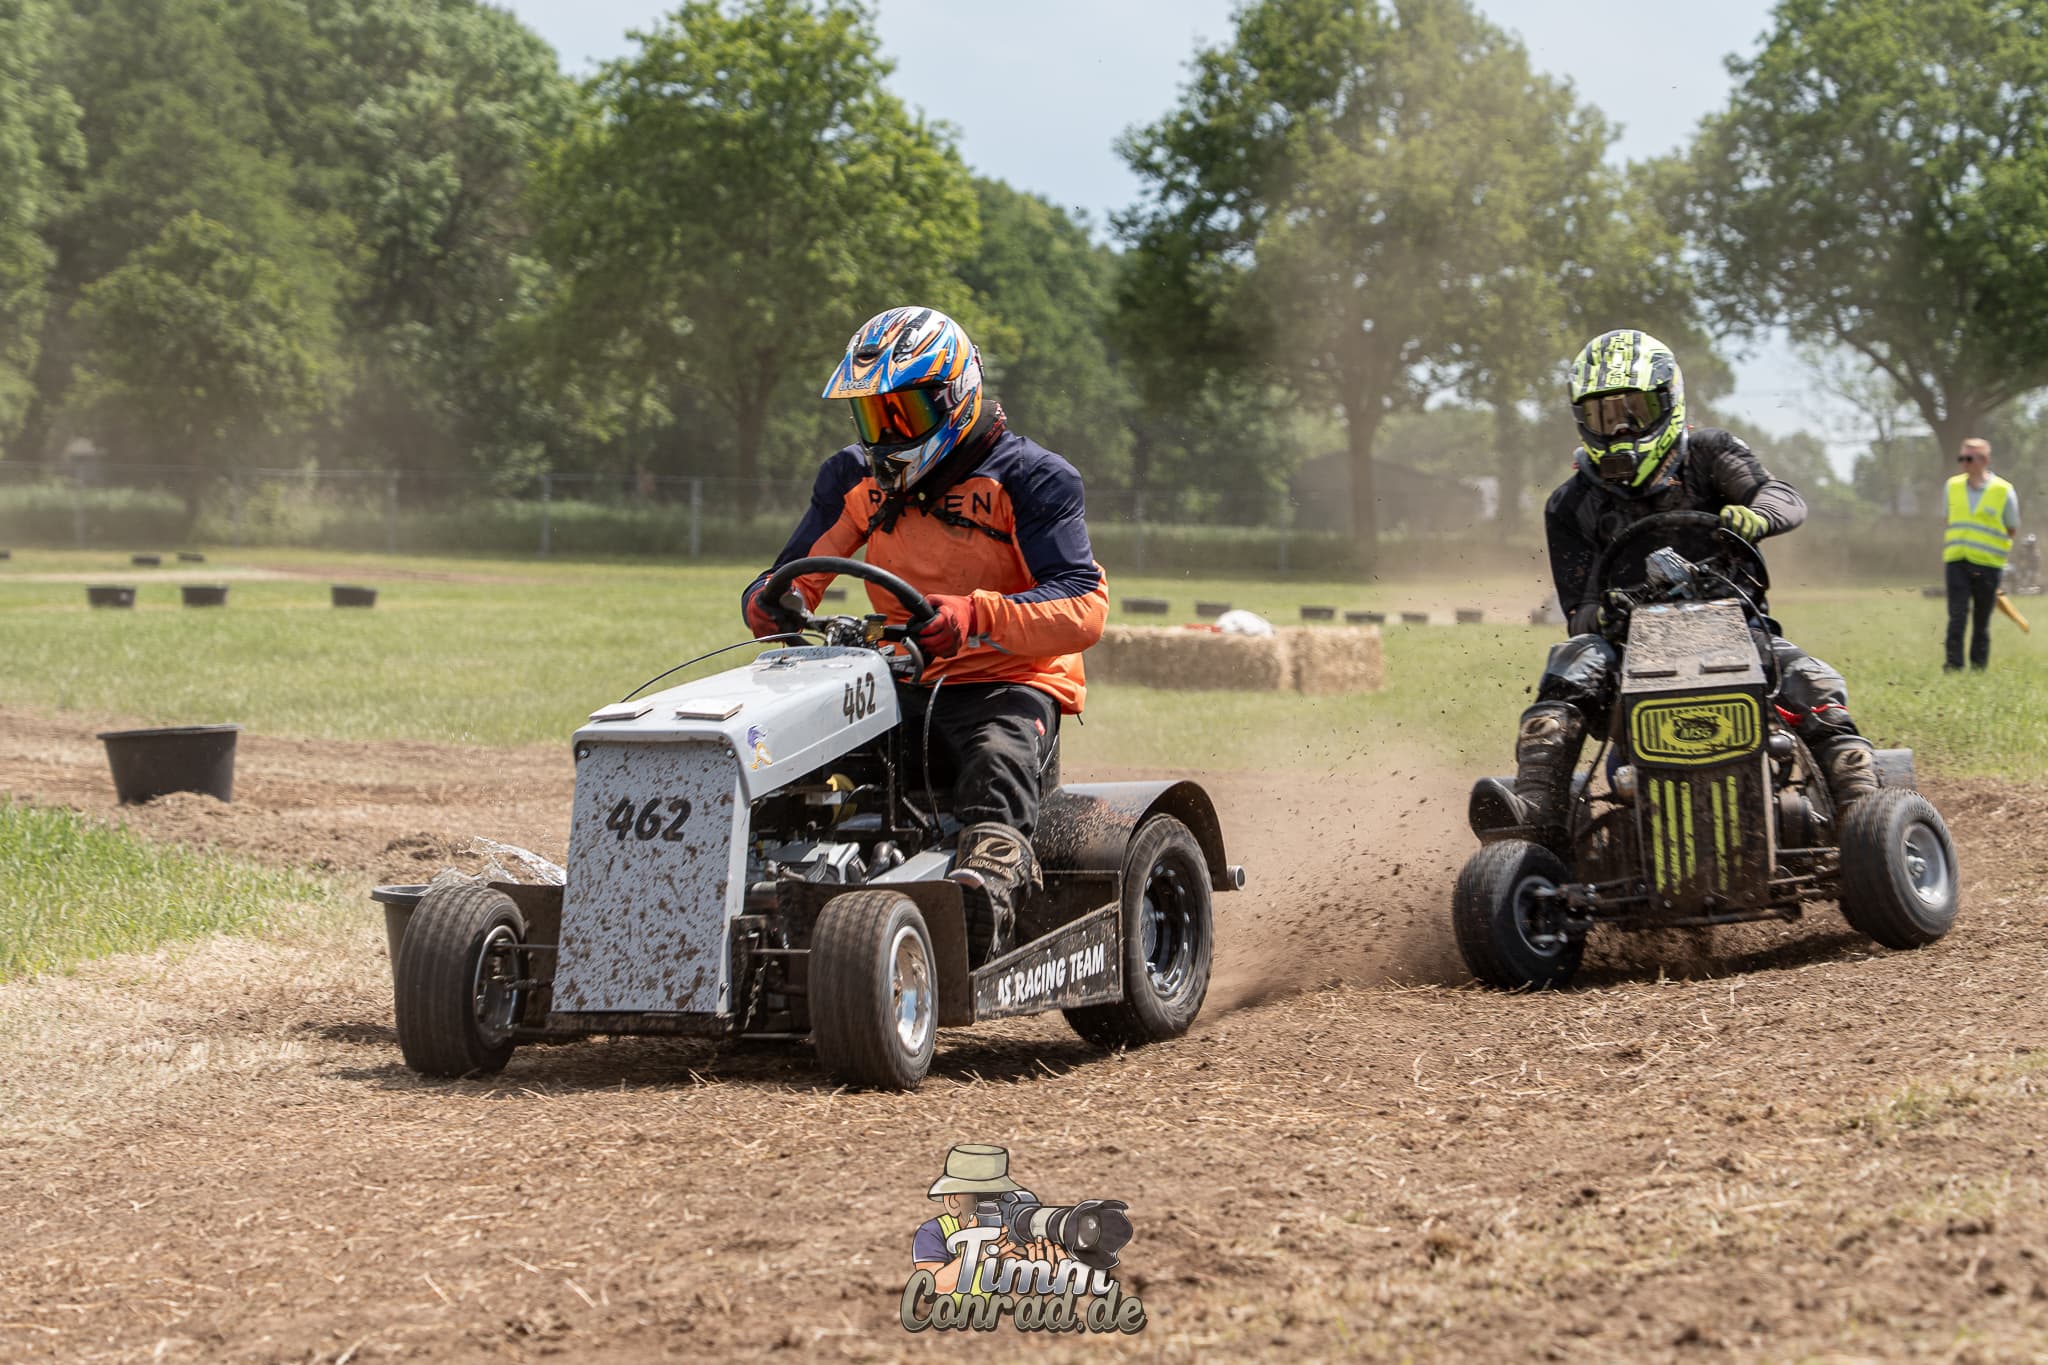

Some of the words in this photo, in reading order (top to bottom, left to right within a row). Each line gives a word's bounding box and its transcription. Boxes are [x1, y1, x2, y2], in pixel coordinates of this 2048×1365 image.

[868, 489, 991, 518] REN
[843, 672, 876, 724] 462
[606, 797, 692, 842] 462
[1070, 942, 1104, 983] TEAM
